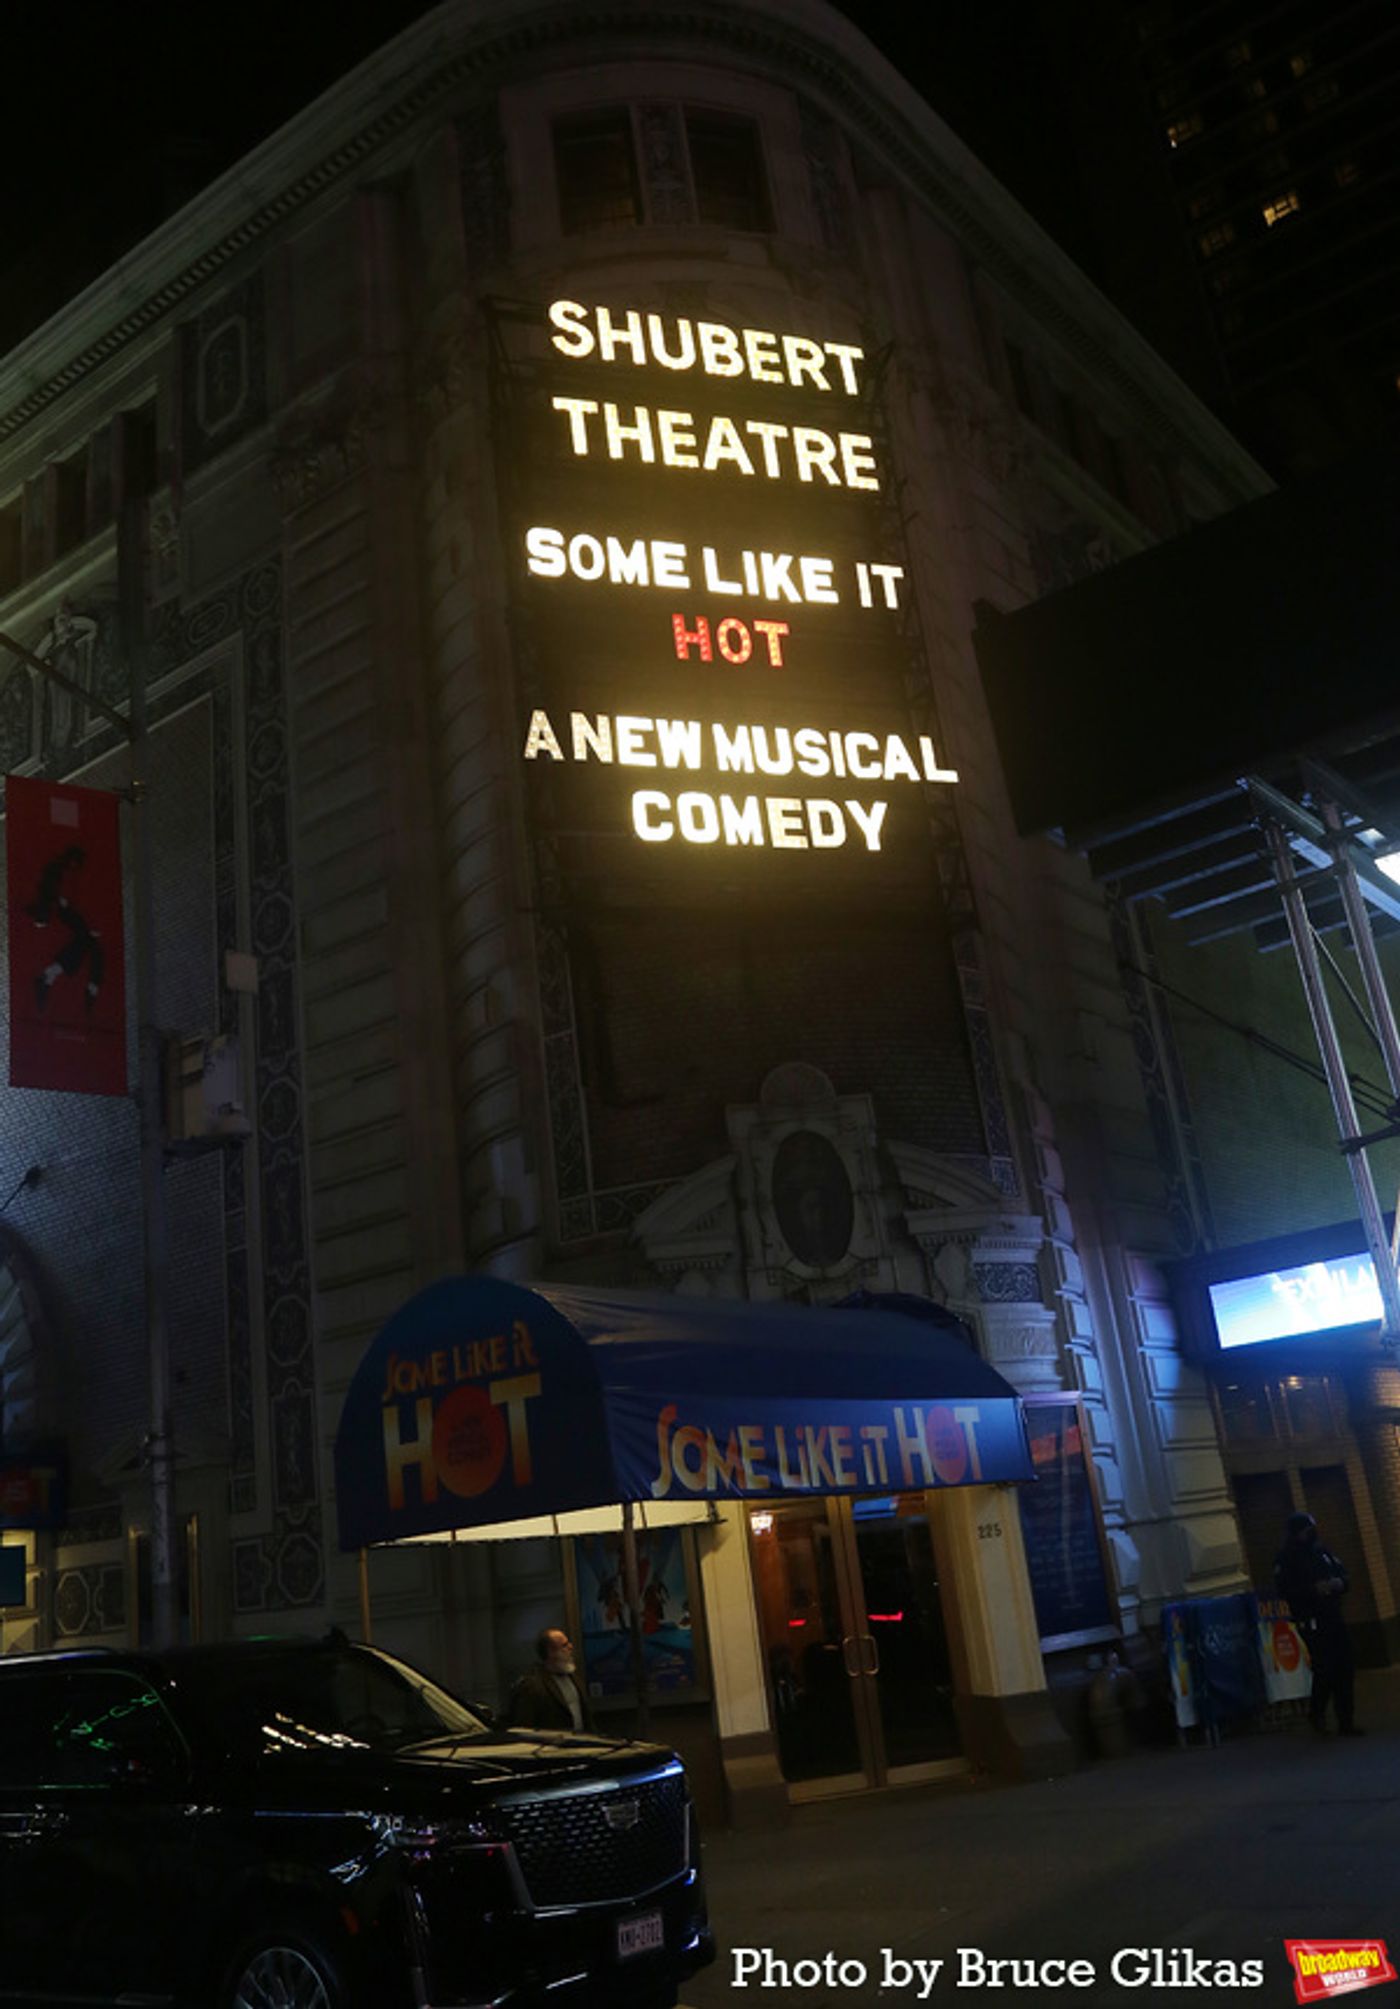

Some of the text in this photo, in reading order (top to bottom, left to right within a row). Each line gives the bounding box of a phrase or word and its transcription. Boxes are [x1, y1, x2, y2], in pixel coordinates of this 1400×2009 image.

[548, 300, 864, 395] SHUBERT
[552, 396, 879, 490] THEATRE
[526, 527, 903, 608] SOME LIKE IT
[671, 613, 789, 667] HOT
[523, 709, 958, 782] A NEW MUSICAL
[631, 790, 887, 851] COMEDY
[381, 1350, 449, 1404] SOME
[381, 1370, 543, 1513] HOT
[650, 1402, 770, 1498] SOME
[893, 1405, 984, 1486] HOT
[977, 1522, 1002, 1539] 225
